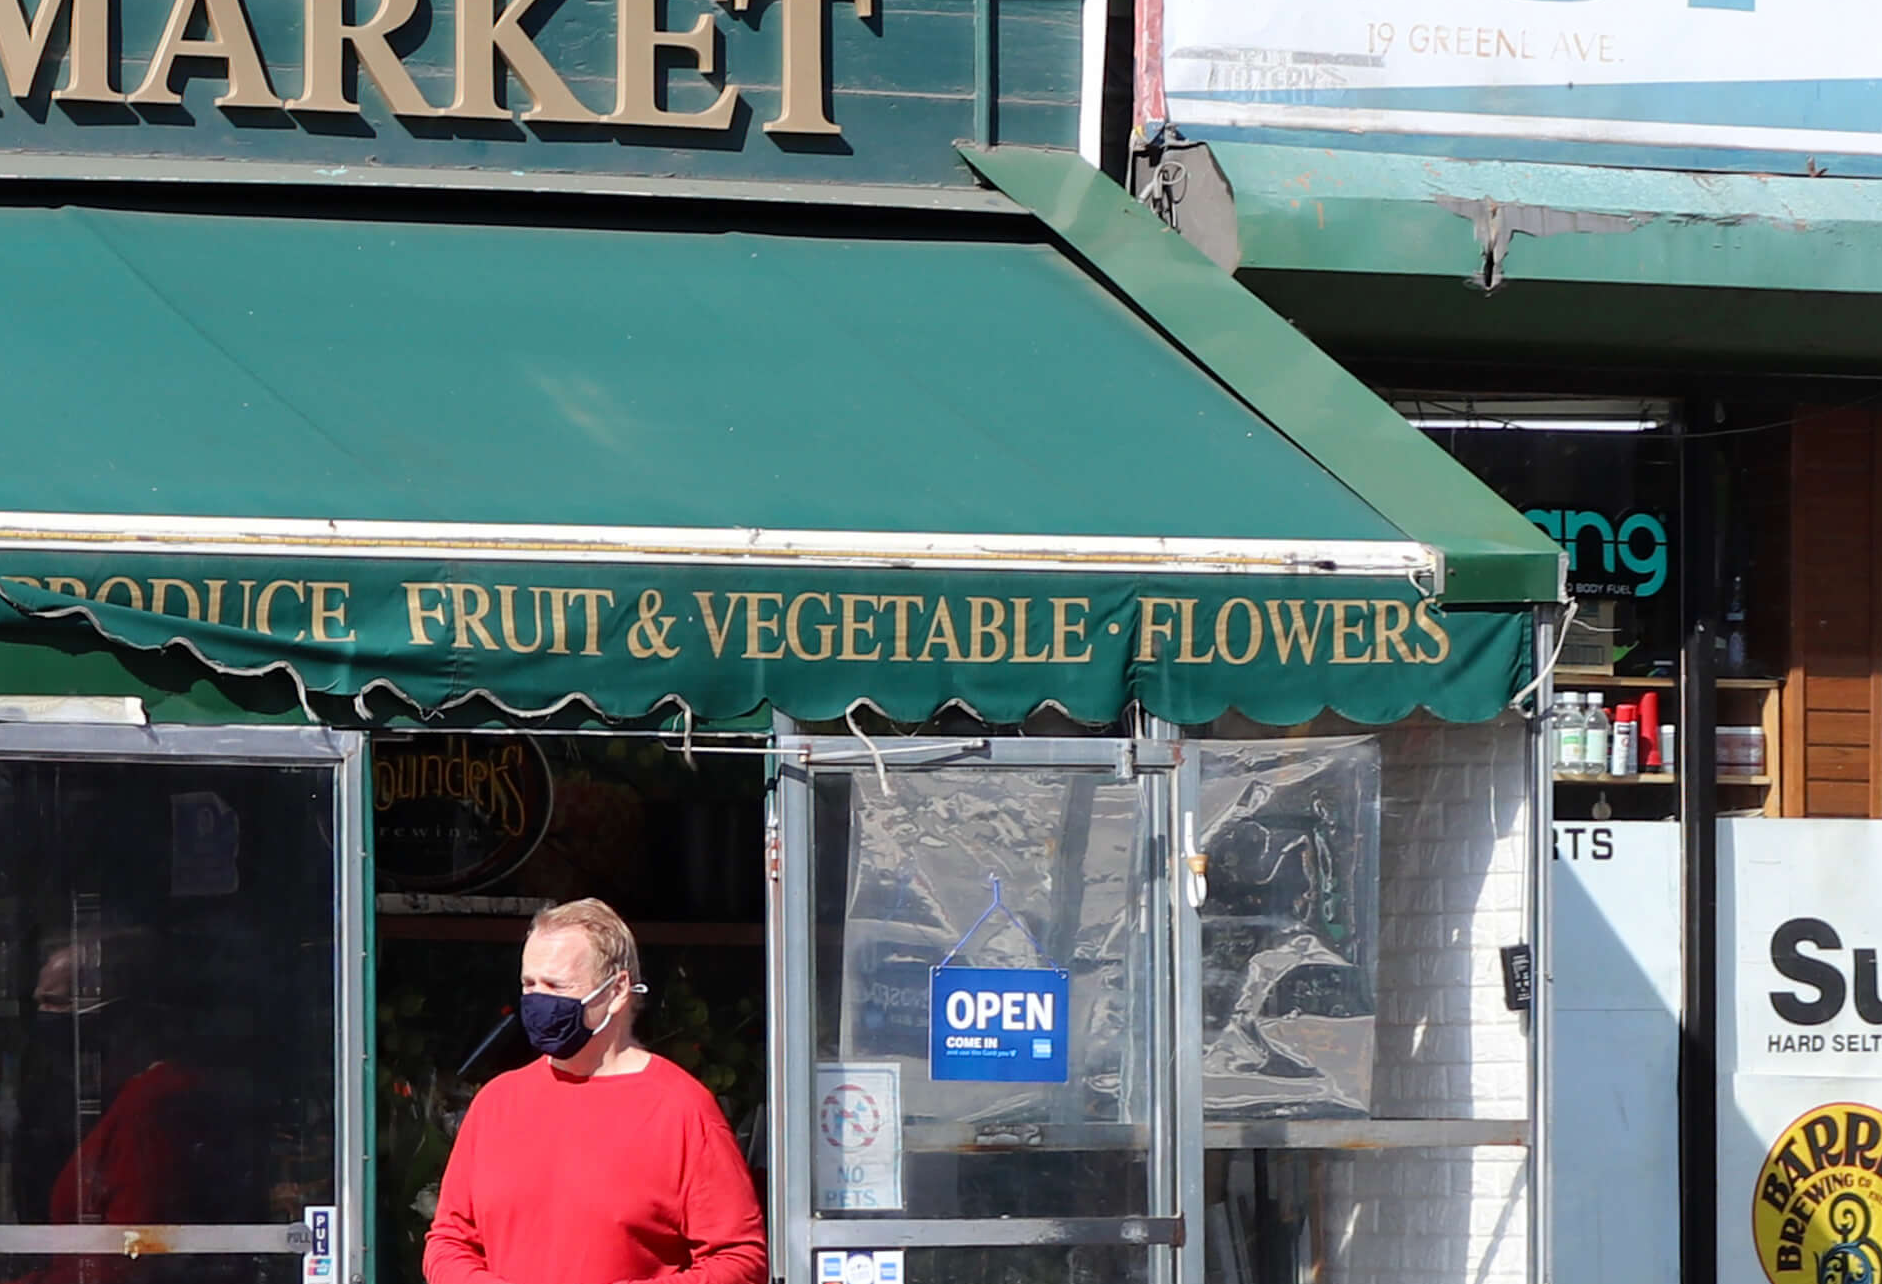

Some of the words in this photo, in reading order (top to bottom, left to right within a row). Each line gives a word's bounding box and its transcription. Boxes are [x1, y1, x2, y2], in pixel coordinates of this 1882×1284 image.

[1366, 21, 1396, 56] 19
[1575, 582, 1603, 594] BODY
[1606, 583, 1632, 595] FUEL
[401, 580, 616, 659] FRUIT
[626, 587, 682, 661] &
[694, 591, 1094, 666] VEGETABLE
[1134, 596, 1452, 667] FLOWERS
[945, 989, 1055, 1032] OPEN
[945, 1036, 982, 1049] COME
[983, 1036, 998, 1049] IN
[1766, 1033, 1825, 1054] HARD
[837, 1165, 865, 1184] NO
[824, 1189, 877, 1208] PETS
[1776, 1172, 1855, 1273] BREWING
[287, 1231, 311, 1244] PULL
